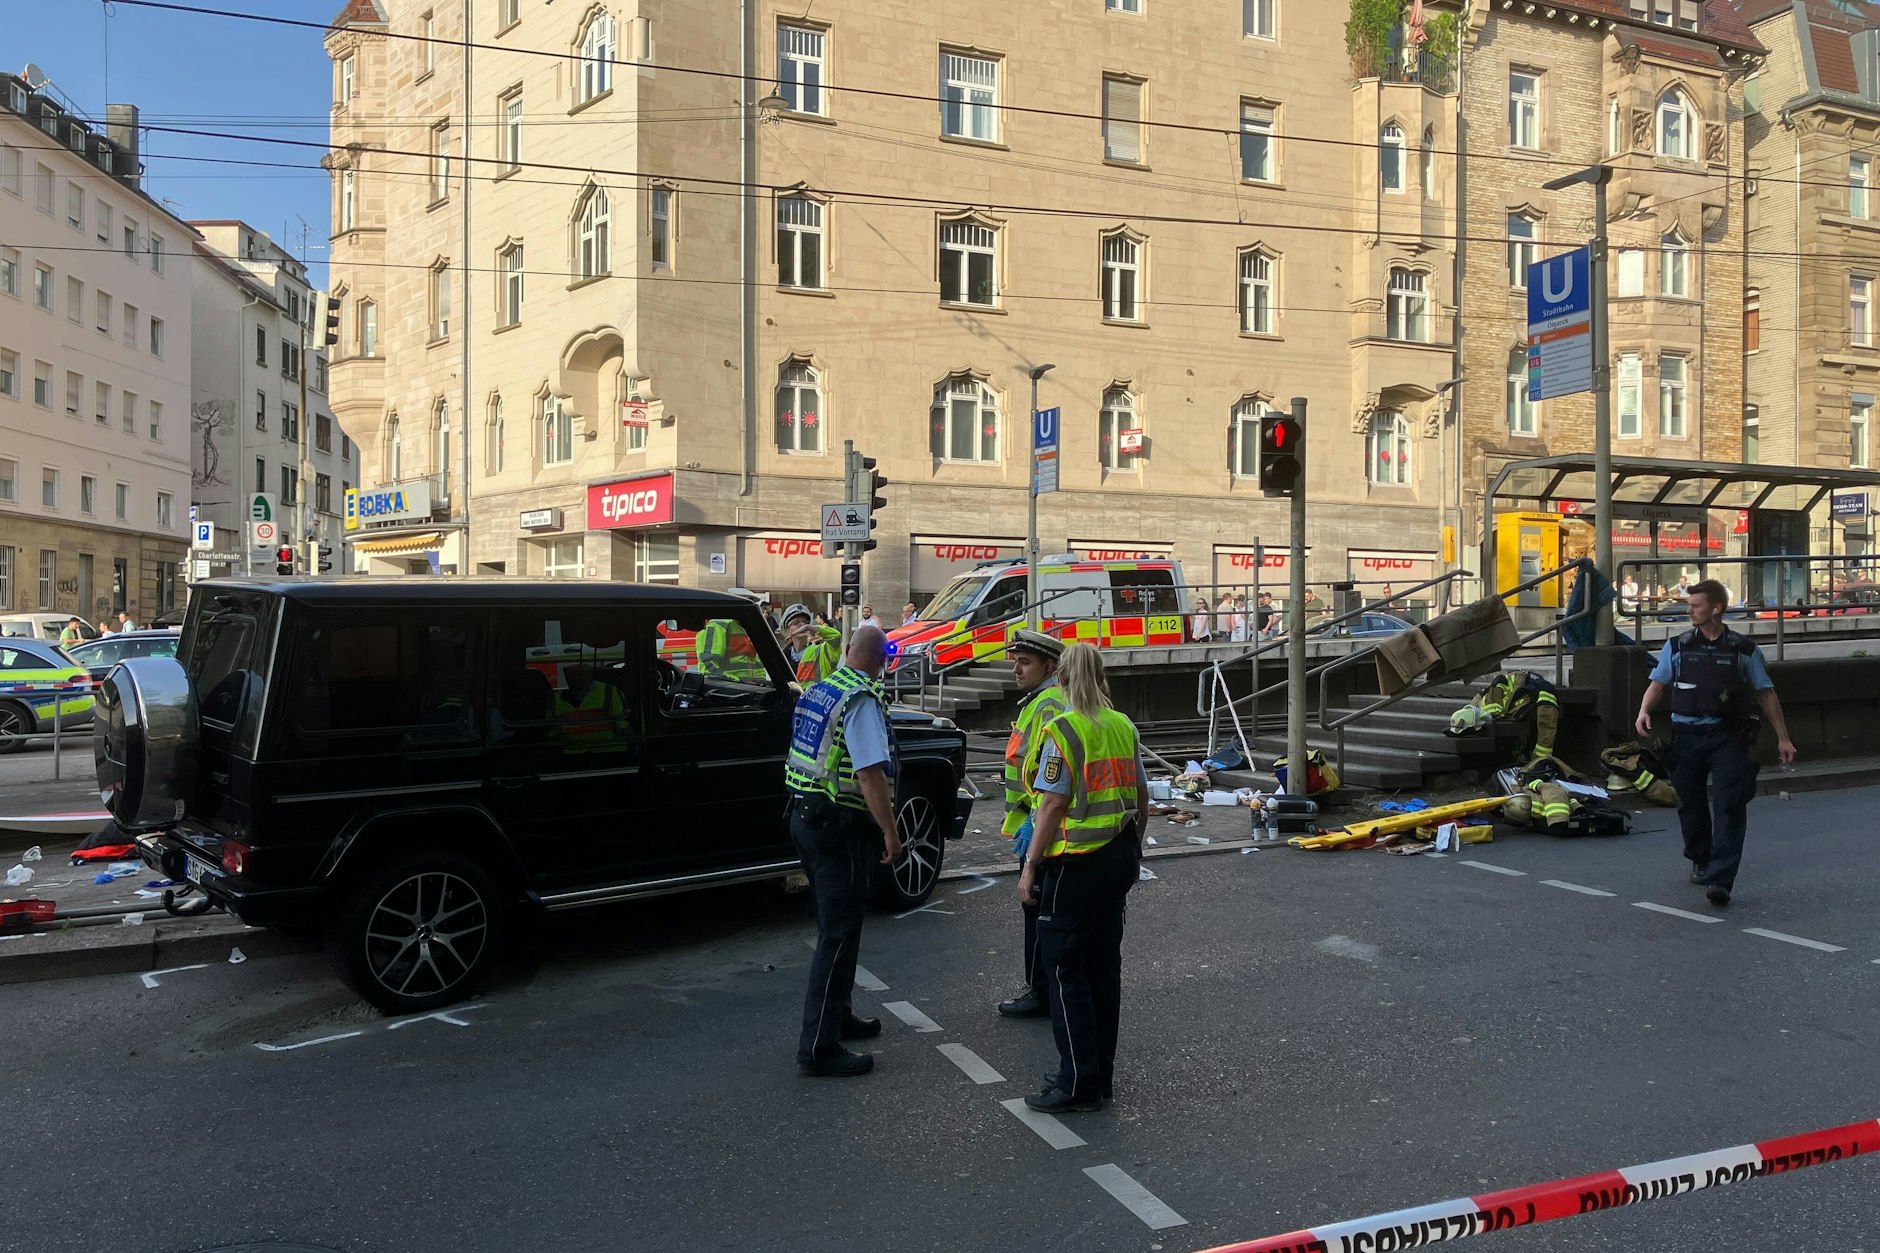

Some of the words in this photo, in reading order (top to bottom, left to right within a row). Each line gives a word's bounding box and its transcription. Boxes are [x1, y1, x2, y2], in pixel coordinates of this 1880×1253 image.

[1542, 254, 1574, 304] U
[1542, 303, 1574, 318] Stadtbahn
[1547, 318, 1569, 329] Olgaeck
[1530, 358, 1540, 367] U6
[1039, 410, 1052, 439] U
[359, 491, 404, 516] EDEKA
[601, 487, 657, 522] tipico
[1642, 507, 1672, 519] Olgaeck
[200, 526, 208, 539] P
[260, 527, 270, 535] 30
[839, 529, 866, 537] Vorrang
[198, 551, 242, 560] Charlottenstr.
[934, 544, 998, 563] tipico
[1230, 553, 1285, 570] tipco
[1158, 619, 1177, 631] 112
